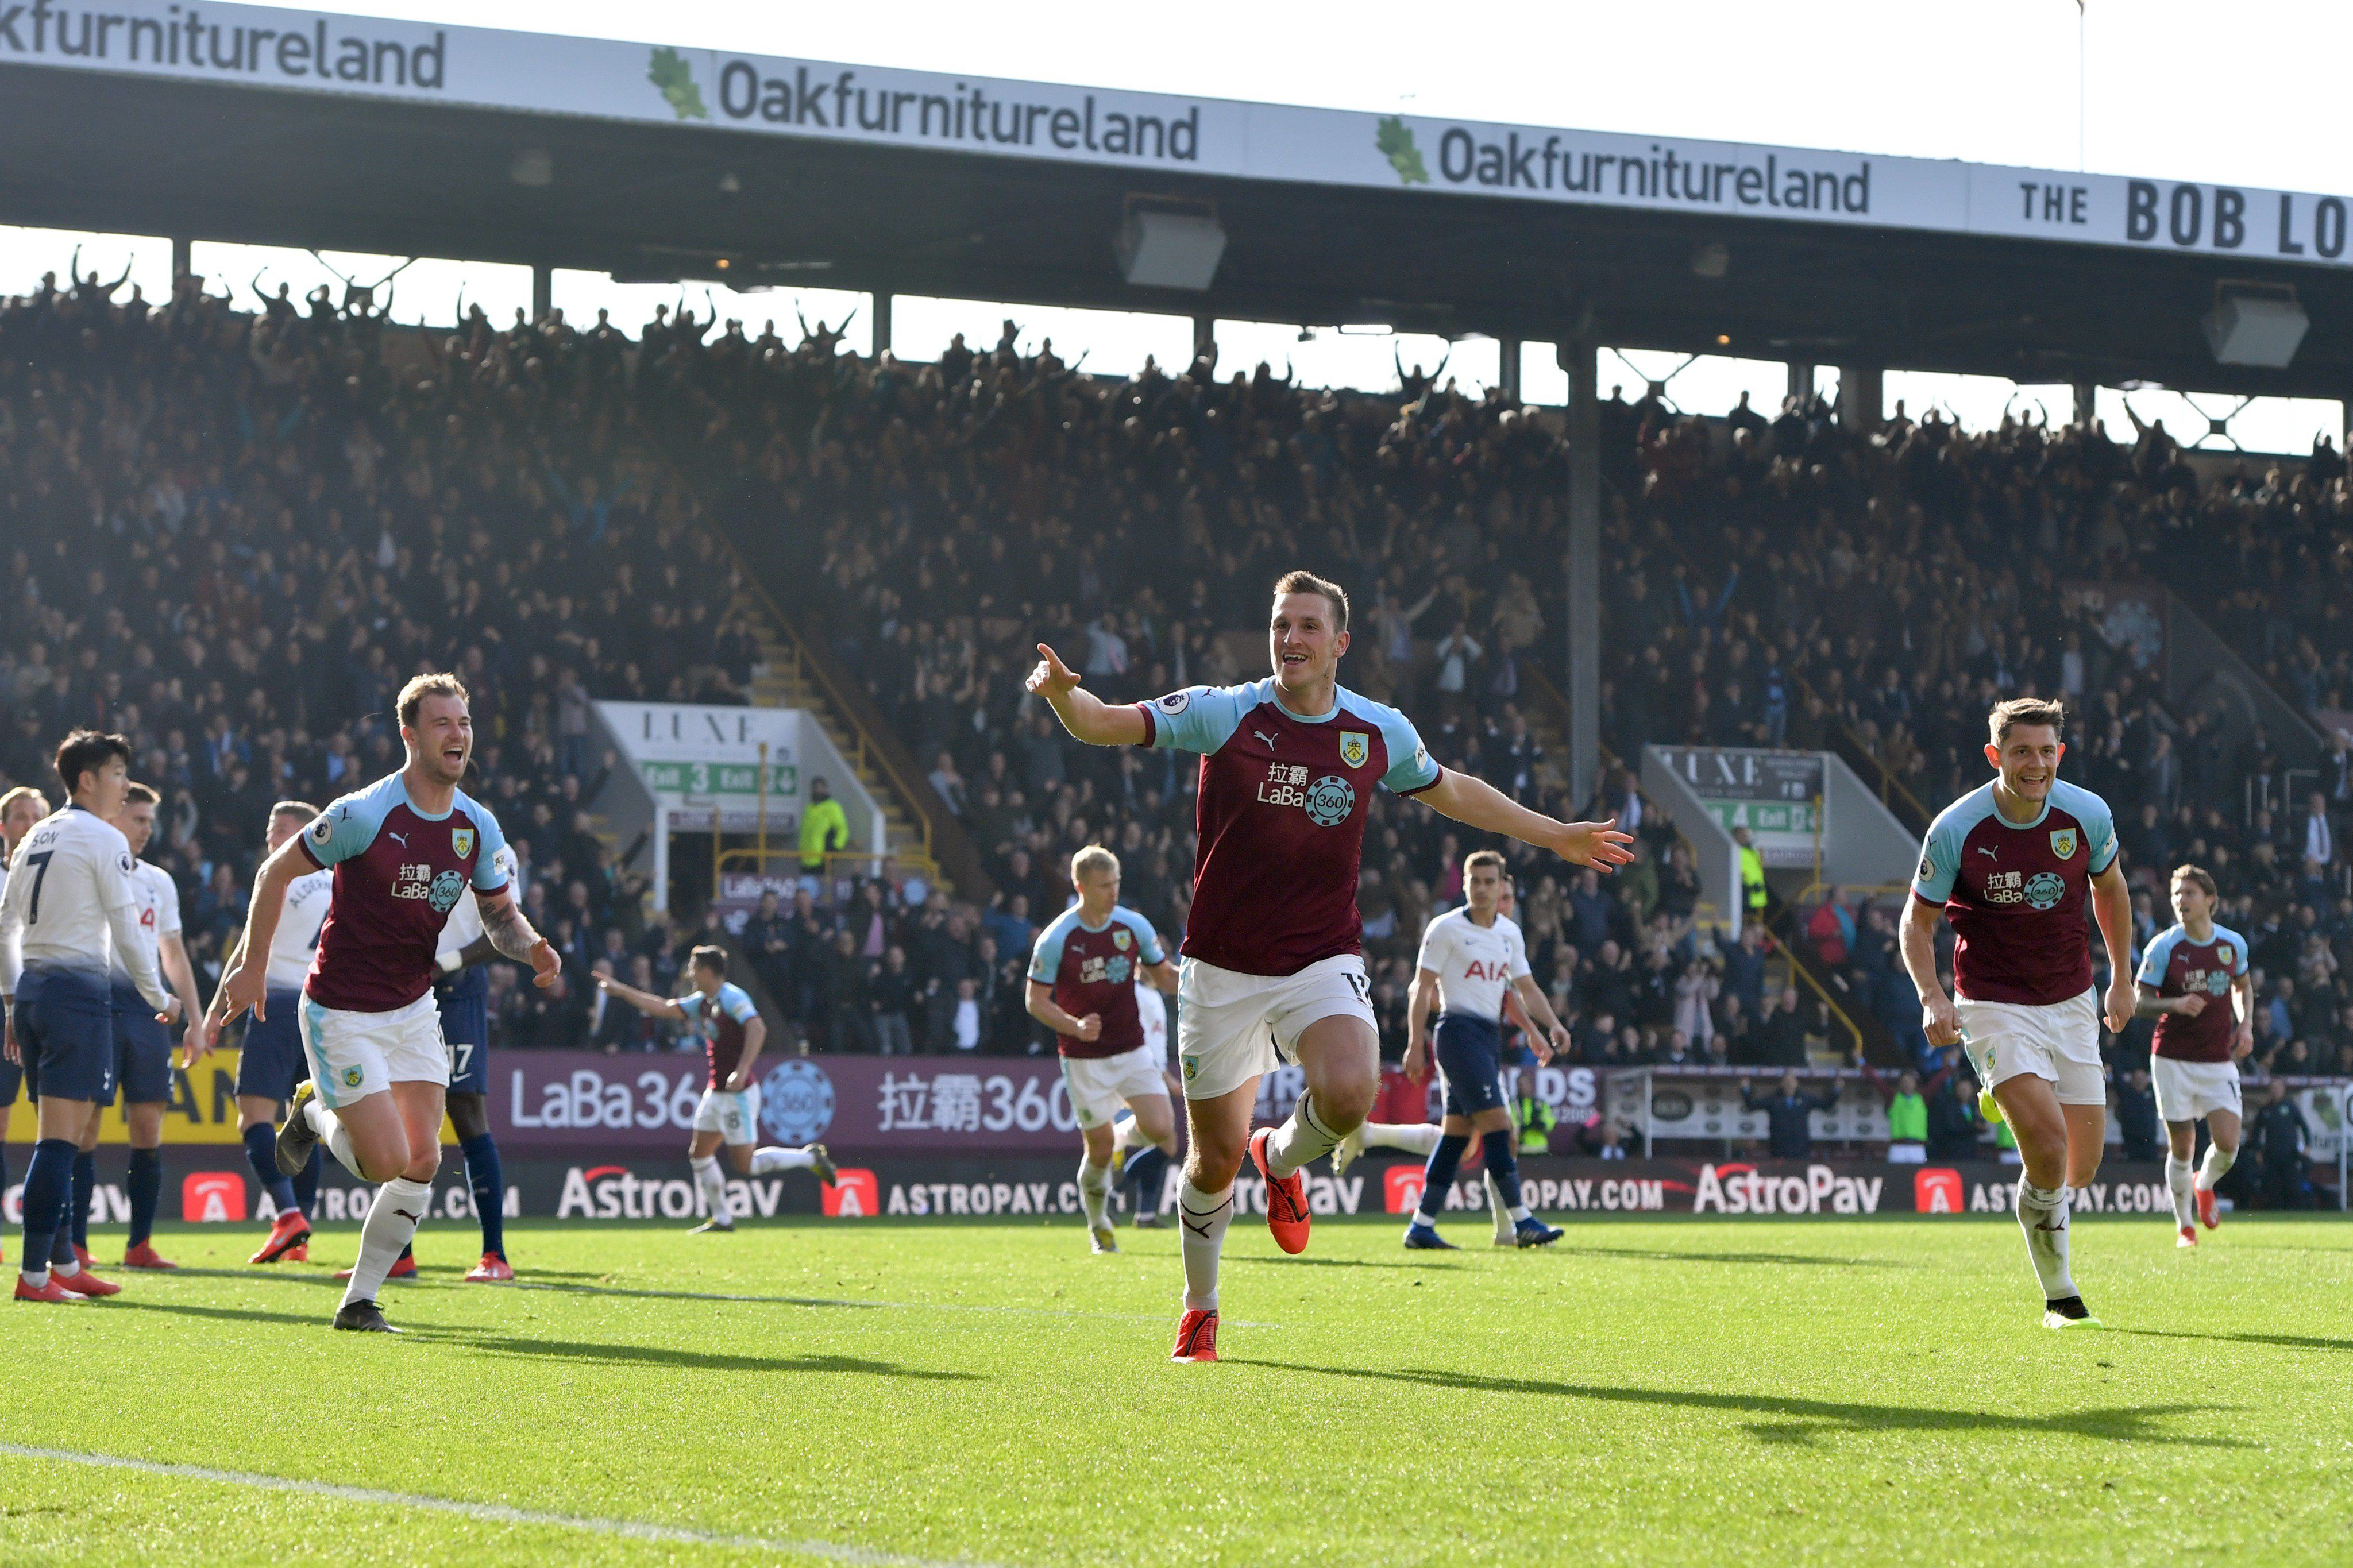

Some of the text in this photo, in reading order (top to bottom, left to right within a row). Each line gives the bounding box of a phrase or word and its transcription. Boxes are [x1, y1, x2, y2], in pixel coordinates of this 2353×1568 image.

[719, 60, 1199, 161] Oakfurnitureland
[1439, 127, 1871, 214] Oakfurnitureland
[2020, 183, 2089, 224] THE
[2126, 178, 2246, 249] BOB
[691, 764, 709, 793] 3
[1267, 762, 1309, 787] 拉霸
[1257, 781, 1305, 808] LaBa
[1317, 794, 1344, 809] 360
[32, 831, 60, 848] SON
[399, 863, 430, 882] 拉霸
[1987, 871, 2022, 890] 拉霸
[26, 850, 55, 925] 7
[391, 881, 429, 899] LaBa
[438, 886, 458, 897] 360
[1983, 889, 2023, 903] LaBa
[446, 1043, 474, 1075] 17
